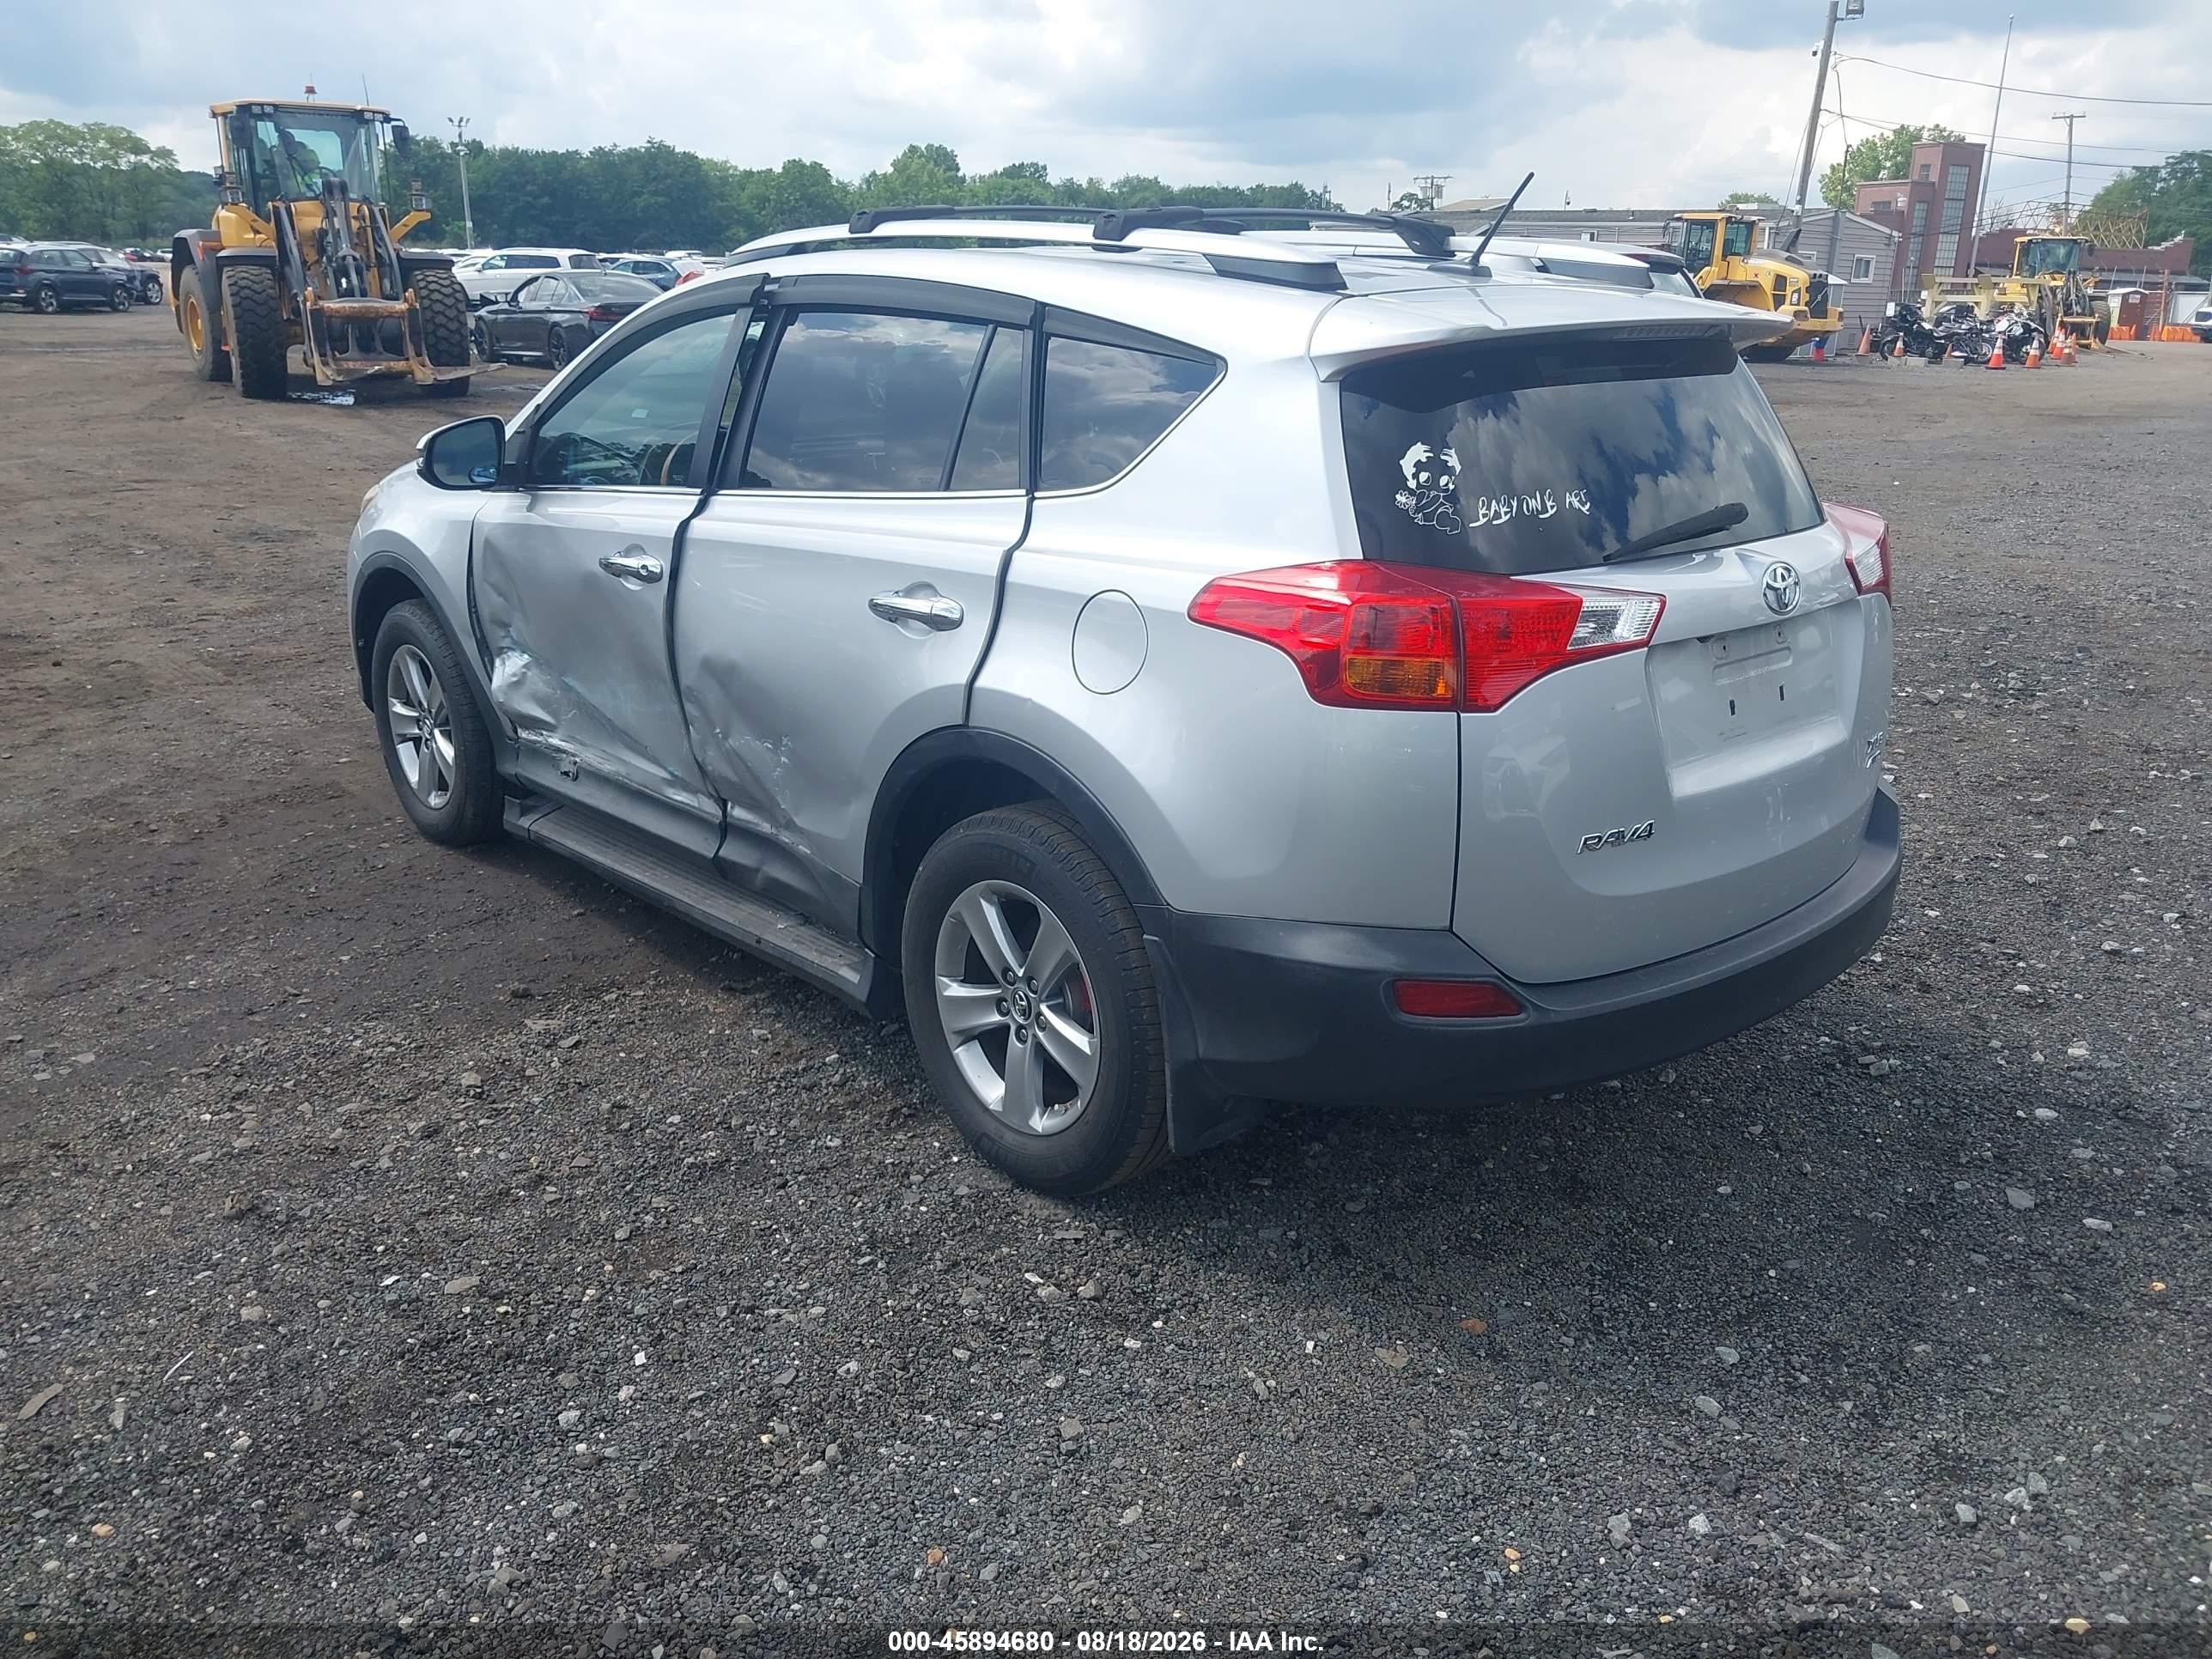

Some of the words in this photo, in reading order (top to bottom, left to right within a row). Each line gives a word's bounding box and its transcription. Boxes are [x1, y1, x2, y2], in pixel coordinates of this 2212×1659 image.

[1468, 494, 1517, 527] BABY
[1521, 489, 1542, 516] ON
[1577, 819, 1656, 854] RAV4
